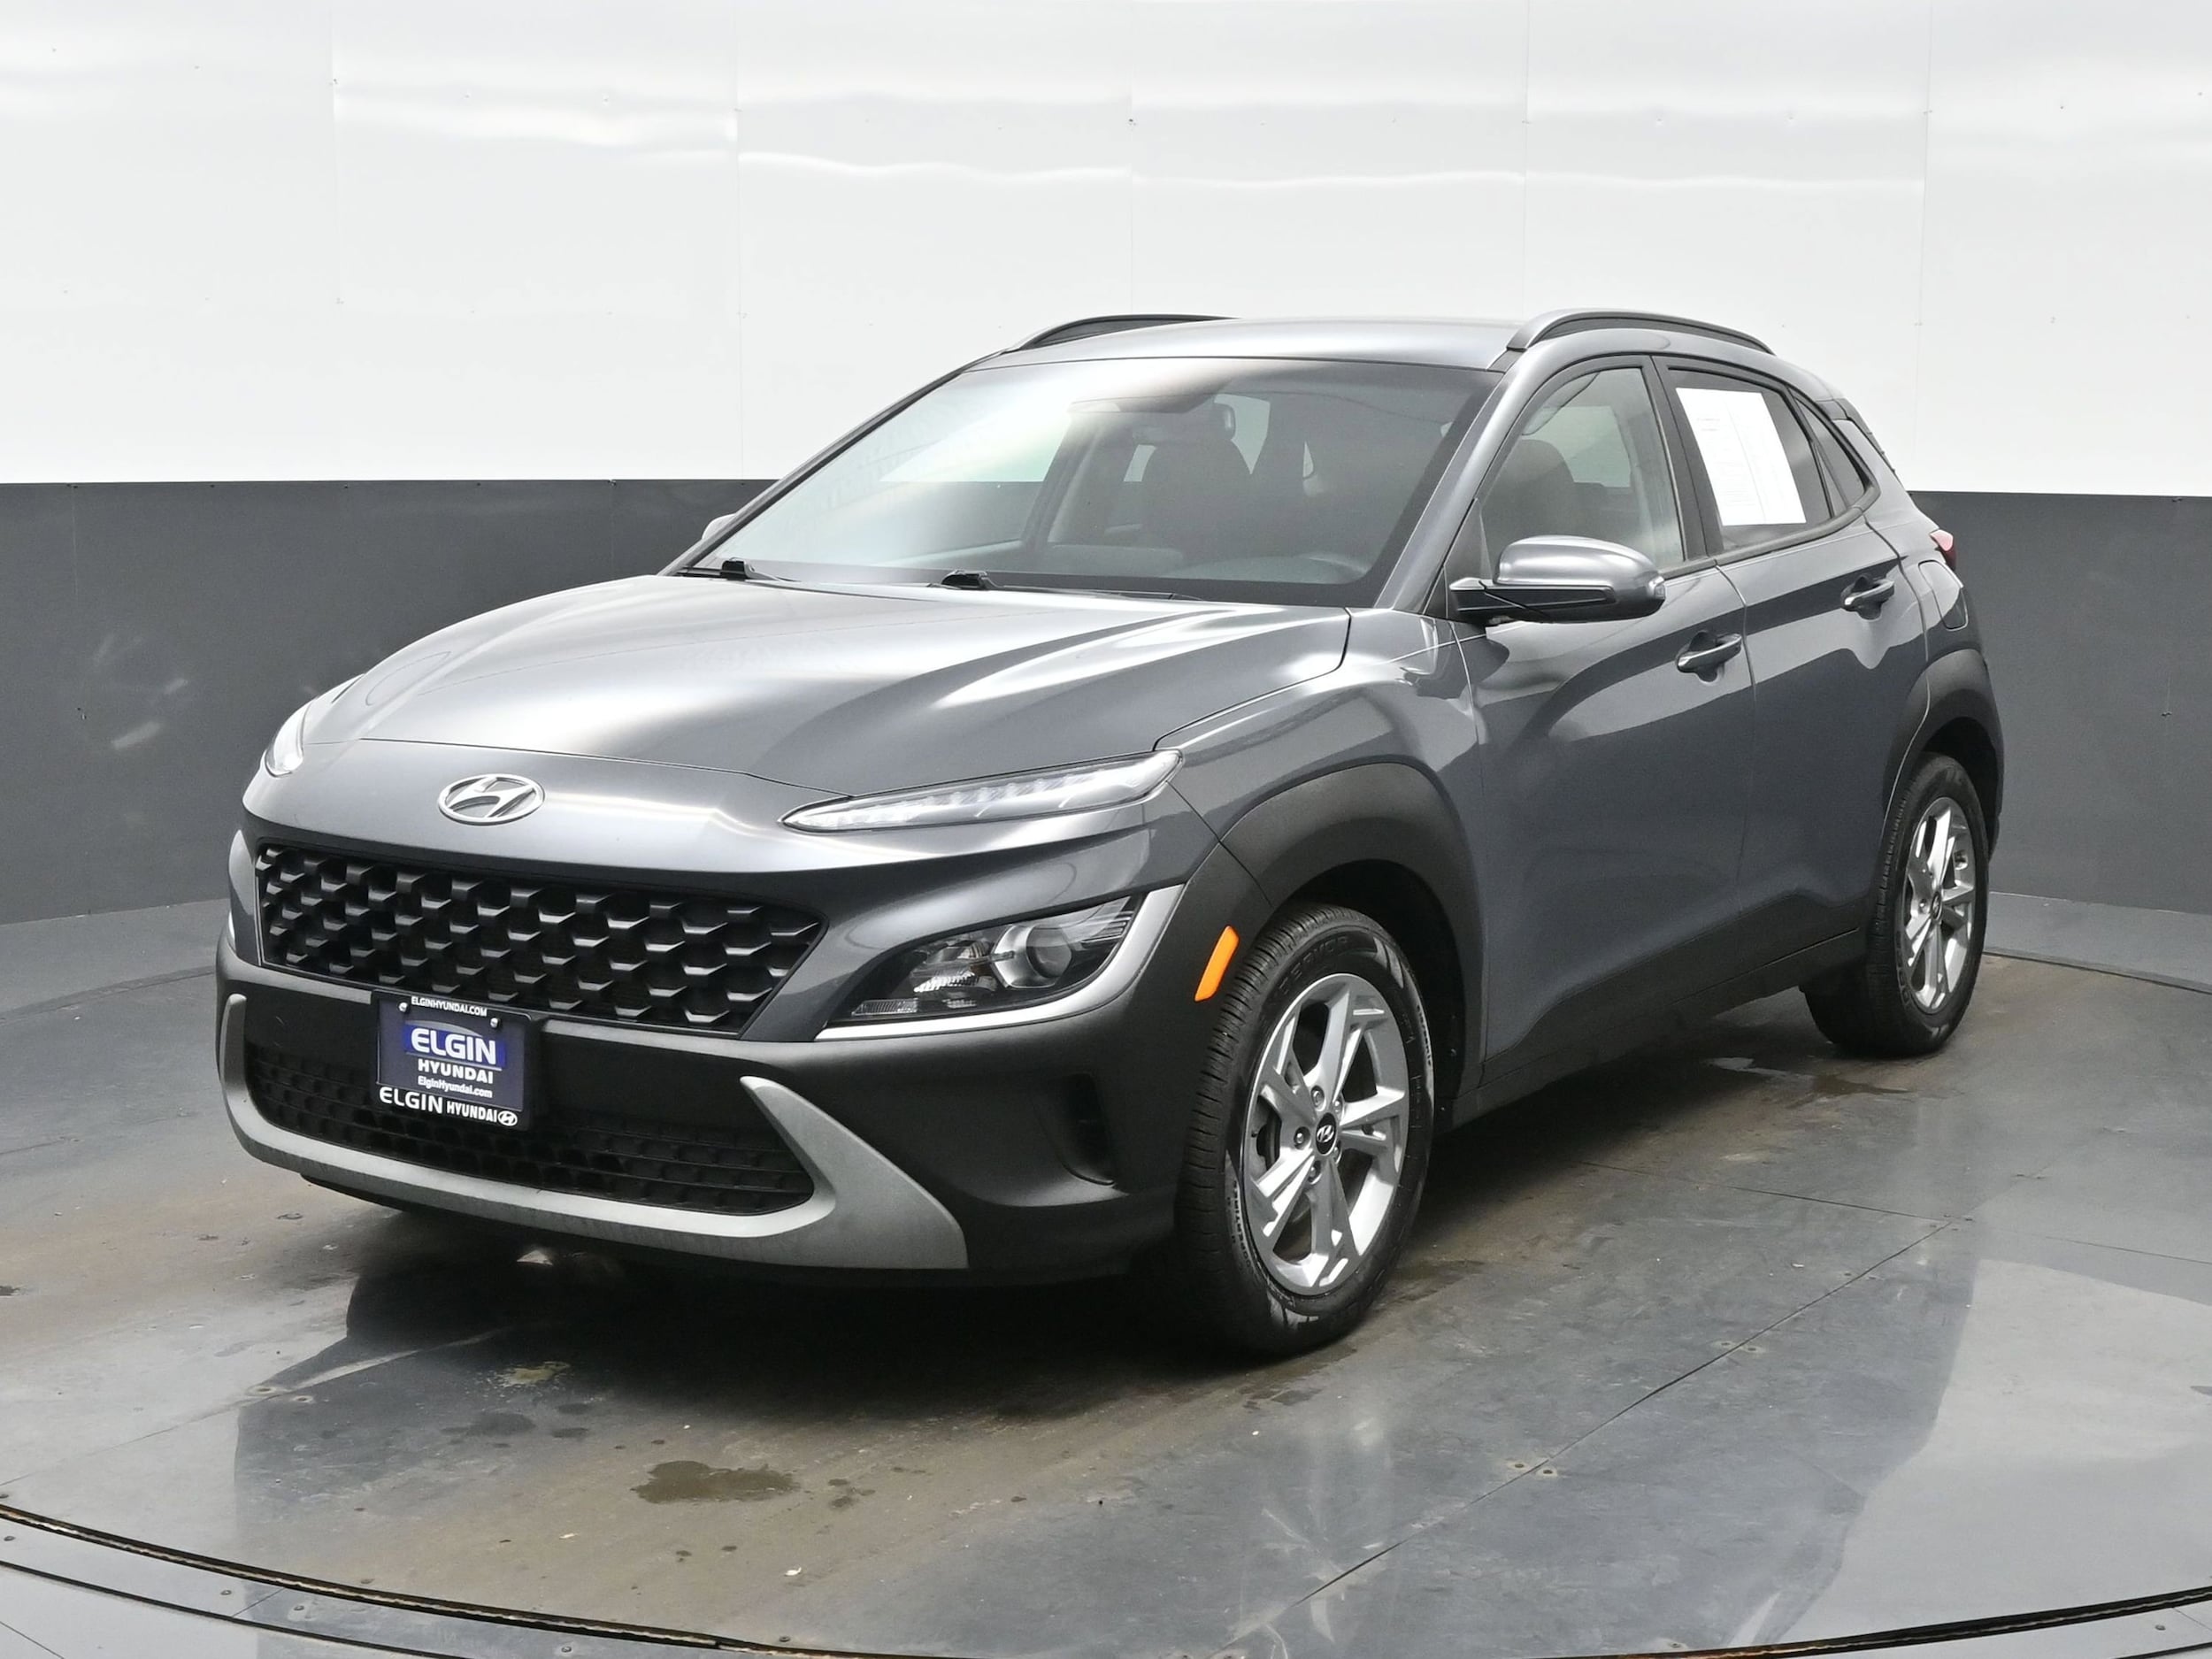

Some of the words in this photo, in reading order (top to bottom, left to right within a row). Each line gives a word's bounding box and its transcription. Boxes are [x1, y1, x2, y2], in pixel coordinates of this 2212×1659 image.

[411, 995, 487, 1017] ELGINHYUNDAI.COM
[411, 1027, 496, 1064] ELGIN
[418, 1058, 494, 1084] HYUNDAI
[418, 1075, 493, 1098] ElginHyundai.com
[379, 1087, 442, 1114] ELGIN
[447, 1101, 497, 1122] HYUNDAI
